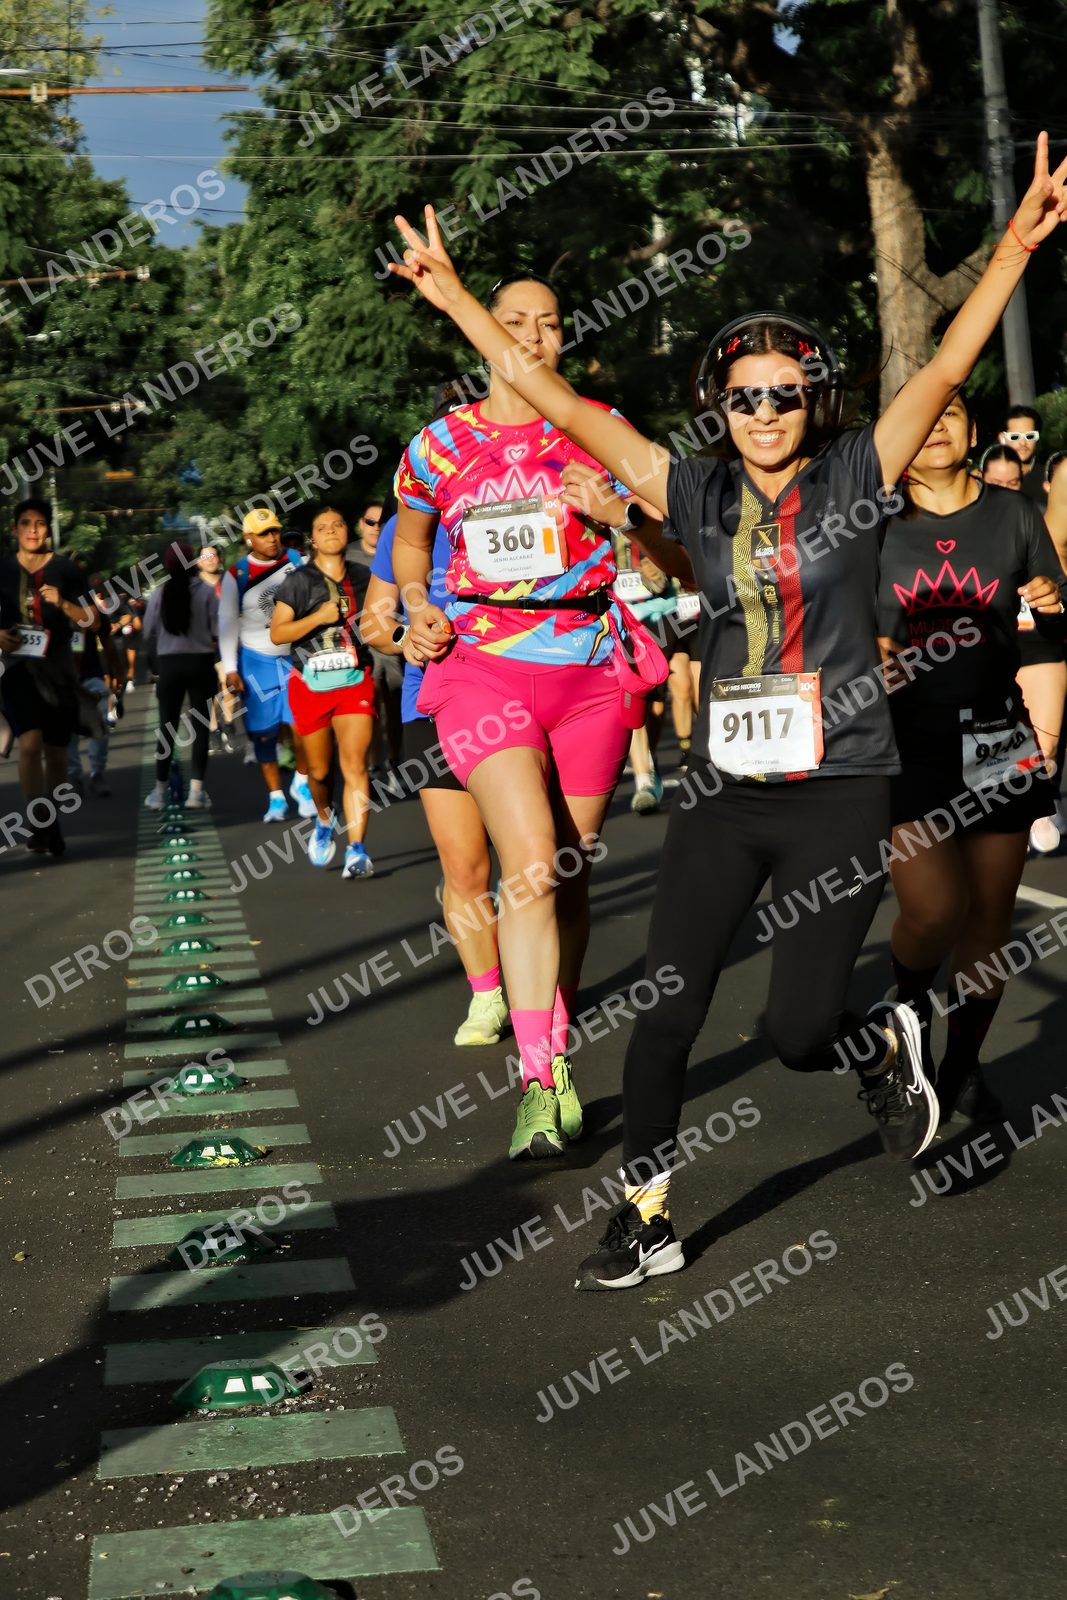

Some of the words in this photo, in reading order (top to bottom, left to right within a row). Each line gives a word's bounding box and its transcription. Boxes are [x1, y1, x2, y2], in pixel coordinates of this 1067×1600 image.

[485, 524, 535, 554] 360
[313, 656, 350, 670] 12495
[722, 707, 794, 743] 9117
